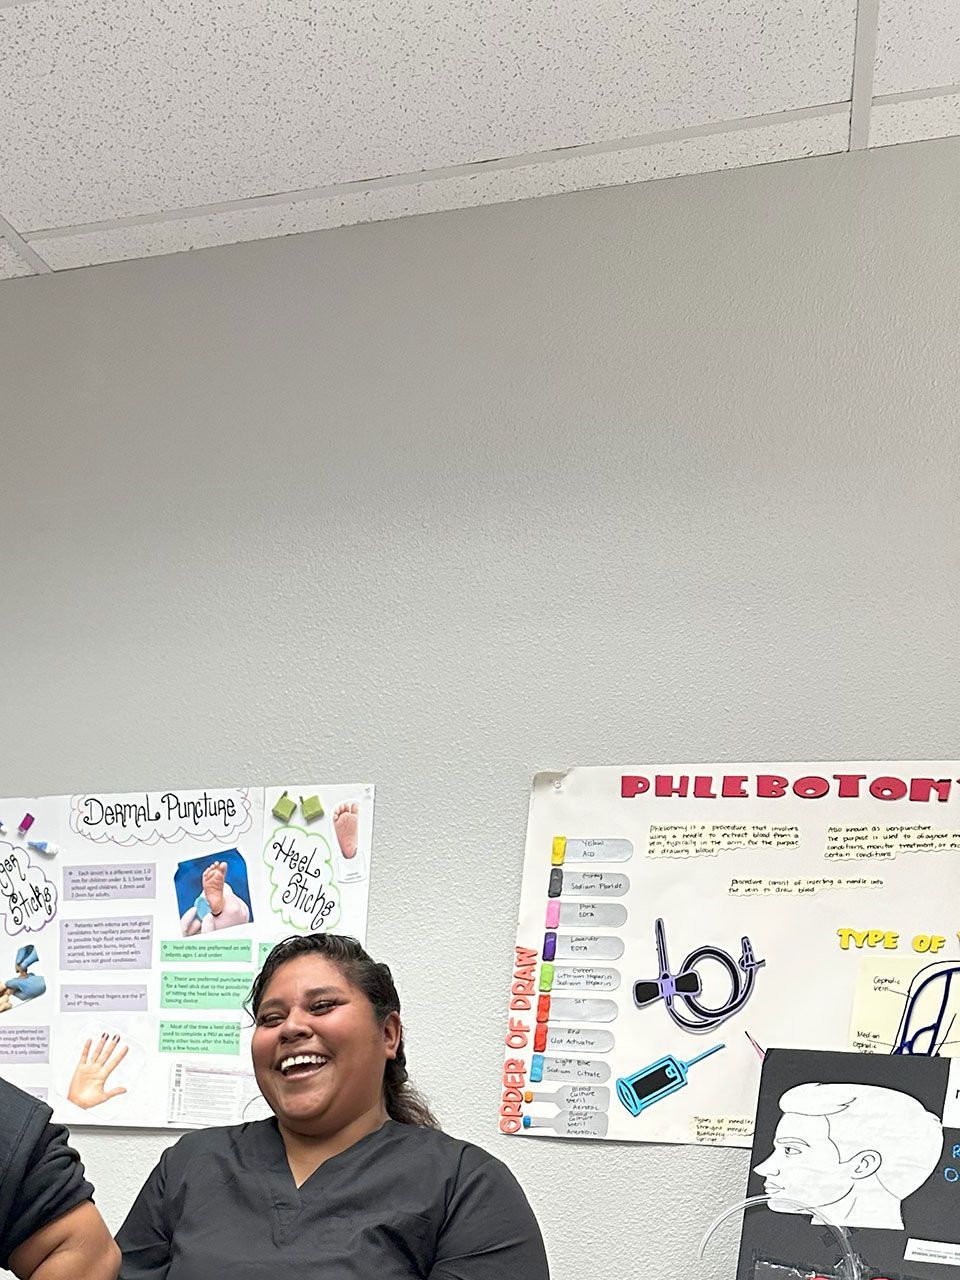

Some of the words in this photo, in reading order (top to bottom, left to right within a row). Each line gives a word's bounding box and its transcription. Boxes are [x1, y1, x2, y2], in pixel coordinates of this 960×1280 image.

[621, 774, 960, 802] PHLEBOTOM
[837, 928, 899, 950] TYPE
[912, 934, 946, 954] OF
[509, 946, 538, 1011] DRAW
[874, 976, 900, 984] Cephalic
[505, 1018, 531, 1049] OF
[499, 1058, 527, 1134] ORDER
